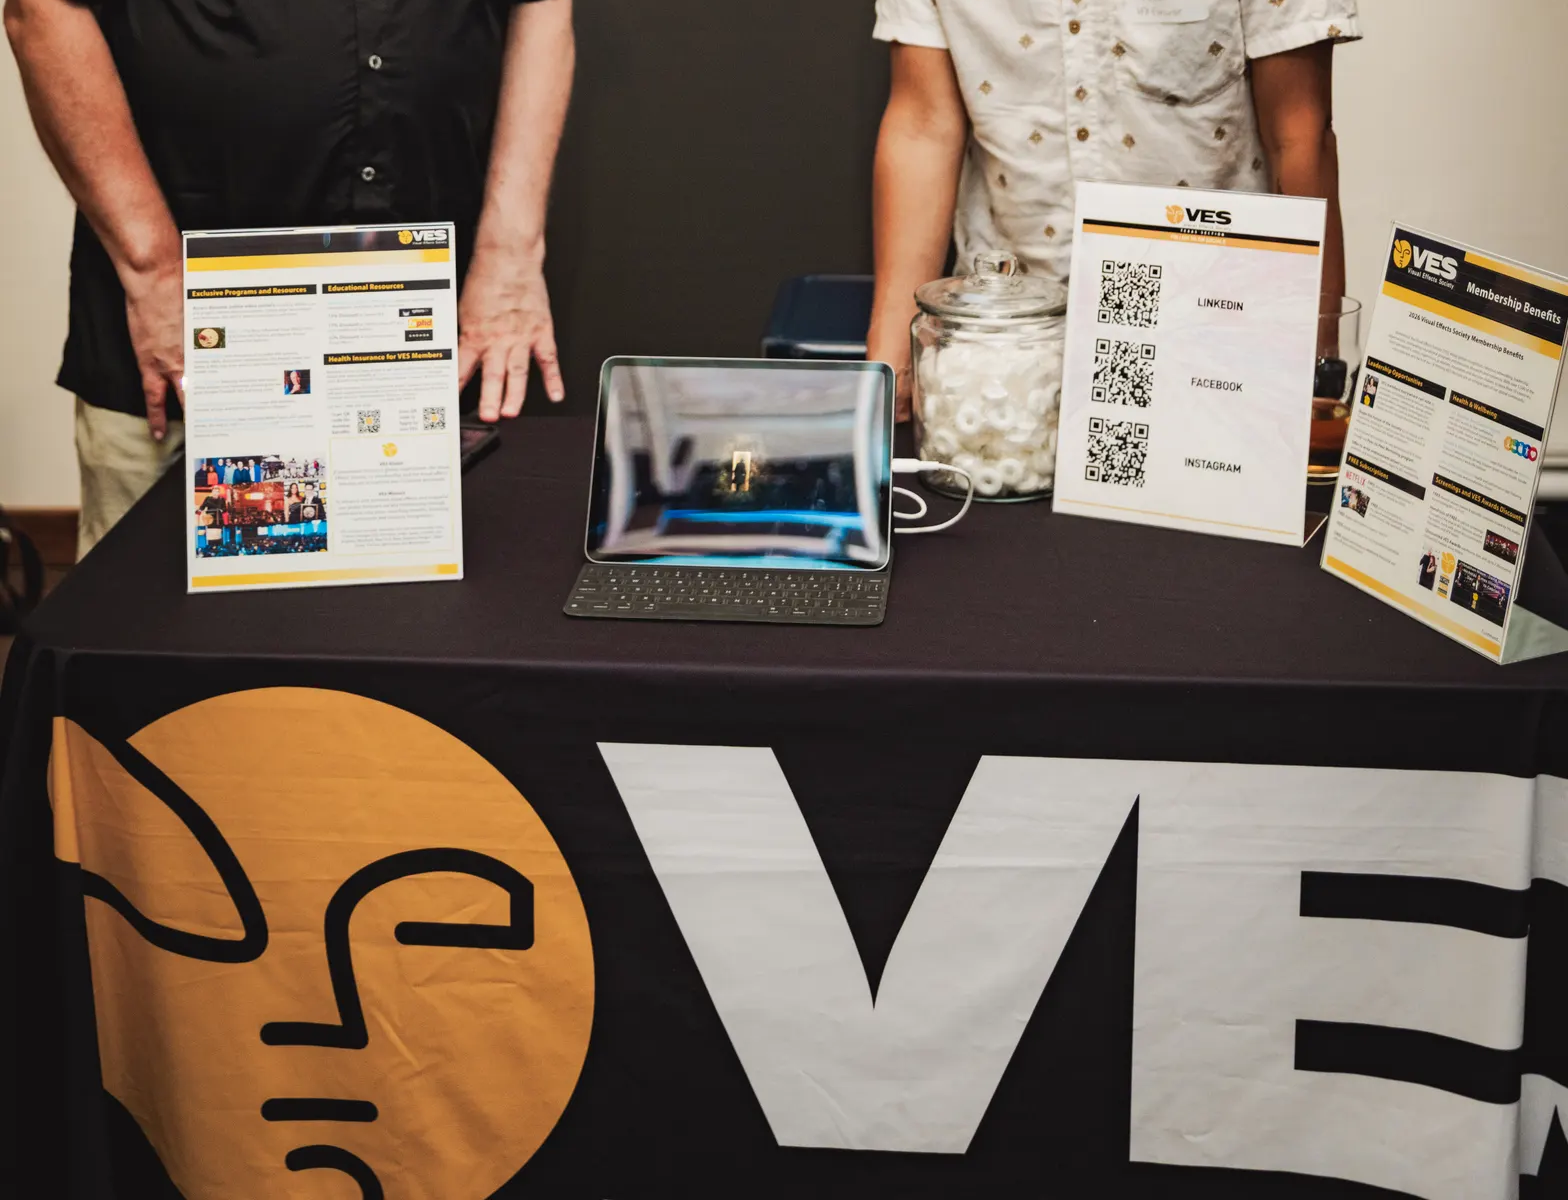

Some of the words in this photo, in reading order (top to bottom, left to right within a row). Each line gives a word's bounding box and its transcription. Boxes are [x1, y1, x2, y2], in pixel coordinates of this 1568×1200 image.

[1186, 208, 1232, 225] VES
[412, 230, 447, 242] VES
[1412, 246, 1458, 281] VES
[1408, 268, 1421, 278] Visual
[1422, 272, 1438, 284] Effects
[1439, 278, 1455, 290] Society
[192, 290, 224, 298] Exclusive
[224, 288, 257, 297] Programs
[328, 284, 368, 292] Educational
[1197, 298, 1244, 311] LINKEDIN
[1466, 282, 1522, 312] Membership
[1523, 302, 1562, 325] Benefits
[1421, 316, 1436, 327] Visual
[1436, 320, 1452, 333] Effects
[1452, 326, 1471, 341] Society
[1472, 334, 1502, 352] Membership
[1502, 347, 1524, 360] Benefits
[397, 352, 410, 360] VES
[1368, 360, 1392, 375] Leadership
[1190, 377, 1244, 392] FACEBOOK
[1452, 394, 1468, 405] Health
[1474, 402, 1498, 419] Wellbeing
[1184, 458, 1242, 474] INSTAGRAM
[1346, 471, 1366, 486] NETFLIX
[1436, 476, 1460, 494] Screenings
[1461, 488, 1472, 497] and
[1471, 492, 1480, 502] VES
[1480, 498, 1499, 511] Awards
[1500, 506, 1523, 522] Discounts
[597, 742, 1568, 1200] VE
